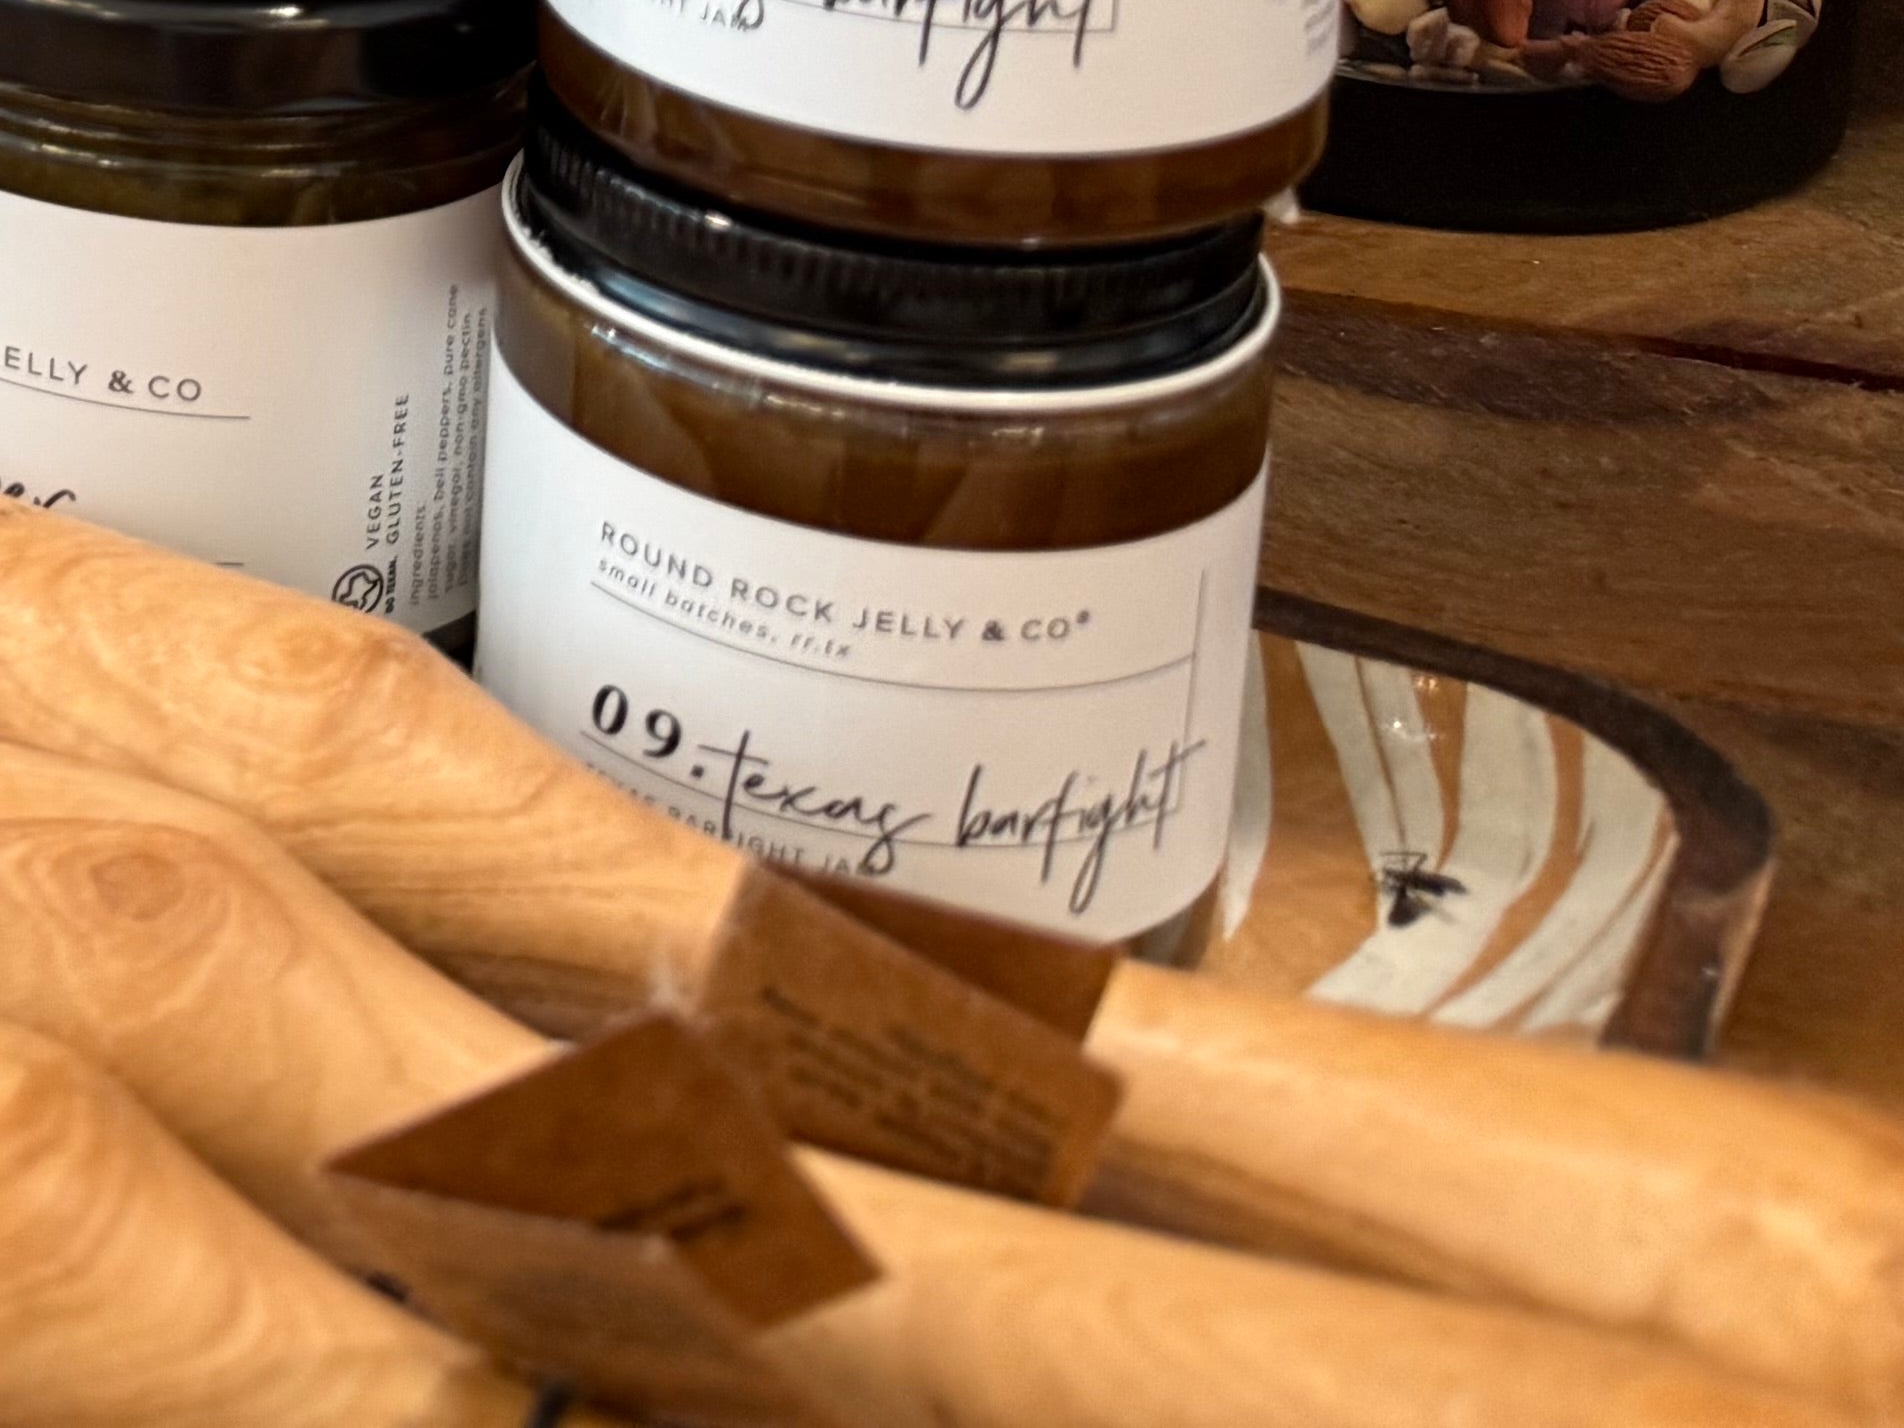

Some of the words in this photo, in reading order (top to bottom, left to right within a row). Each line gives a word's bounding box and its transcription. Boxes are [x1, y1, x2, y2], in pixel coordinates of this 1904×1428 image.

[106, 368, 134, 396] &
[146, 373, 203, 404] CO
[365, 473, 385, 551] VEGAN
[385, 393, 410, 546] GLUTEN-FREE
[595, 555, 658, 599] small
[663, 587, 778, 644] batches,
[599, 520, 716, 590] ROUND
[728, 577, 835, 623] ROCK
[851, 605, 966, 642] JELLY
[980, 619, 1006, 643] &
[954, 738, 1208, 915] barfight
